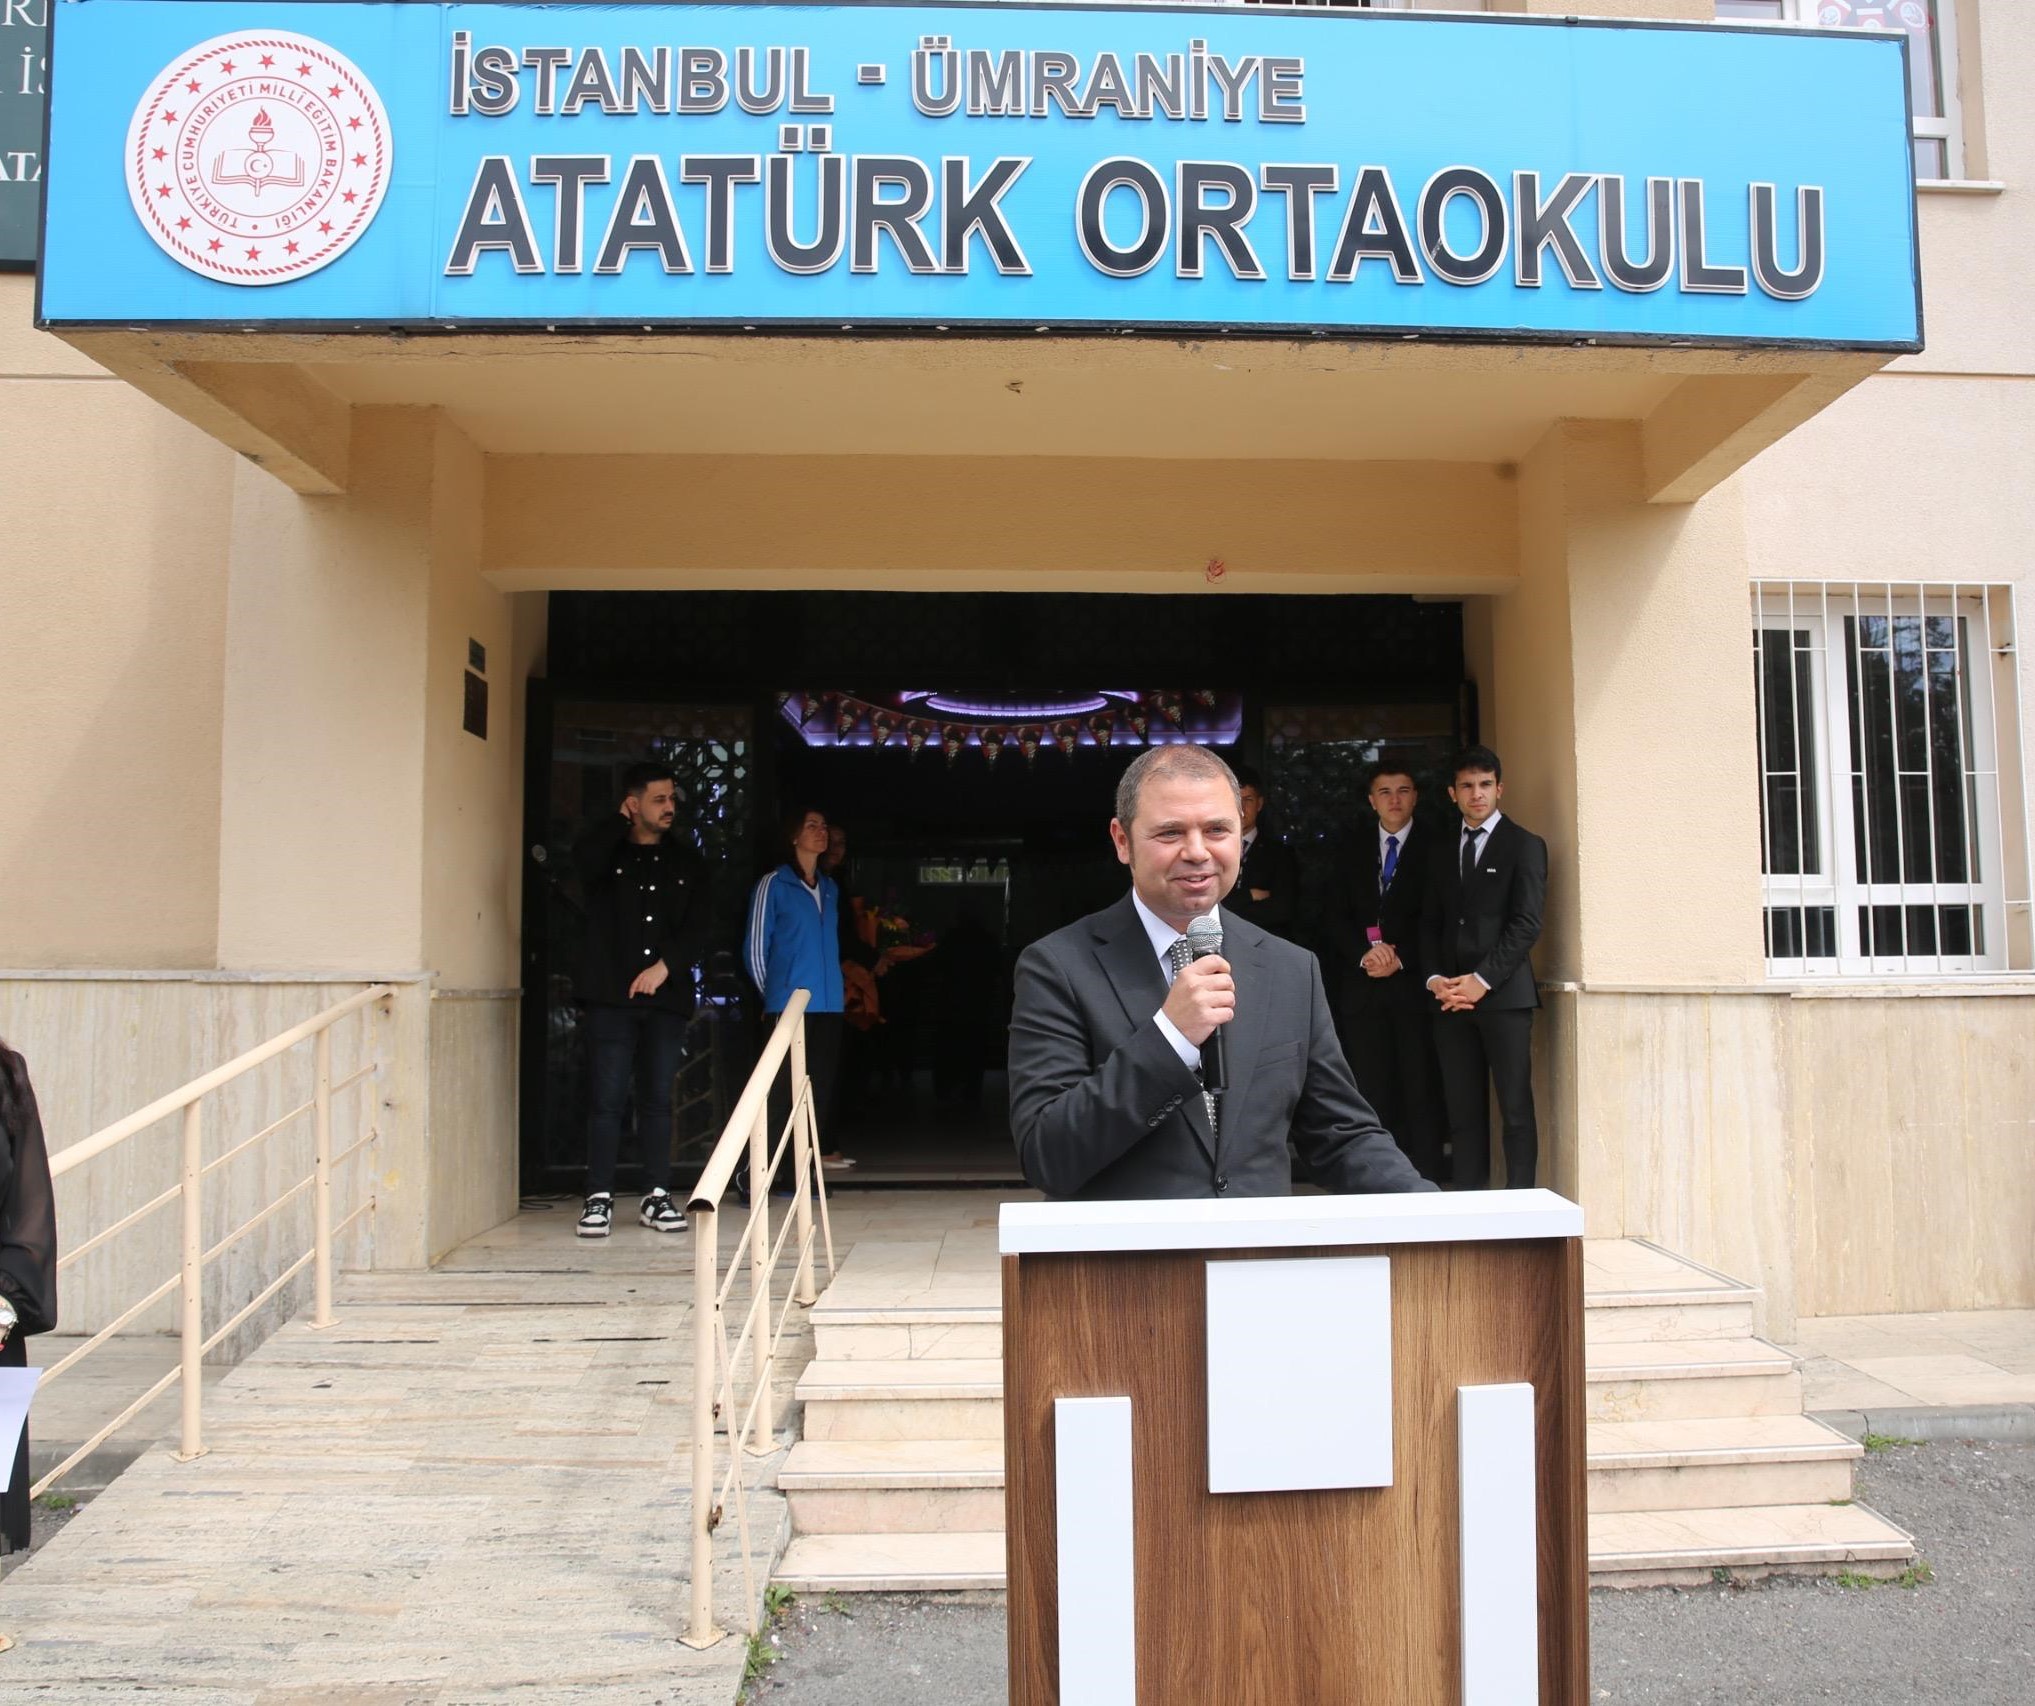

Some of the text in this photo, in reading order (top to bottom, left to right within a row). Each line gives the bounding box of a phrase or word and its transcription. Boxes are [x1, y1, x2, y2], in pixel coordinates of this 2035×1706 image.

[450, 31, 835, 116] İSTANBUL
[911, 35, 1307, 124] ÜMRANİYE
[183, 81, 254, 170] CUMHURİYETİ
[304, 101, 338, 151] EĞİTİM
[185, 175, 239, 230] TÜRKİYE
[275, 158, 338, 229] BAKANLIĞI
[444, 123, 1826, 301] ATATÜRK ORTAOKULU
